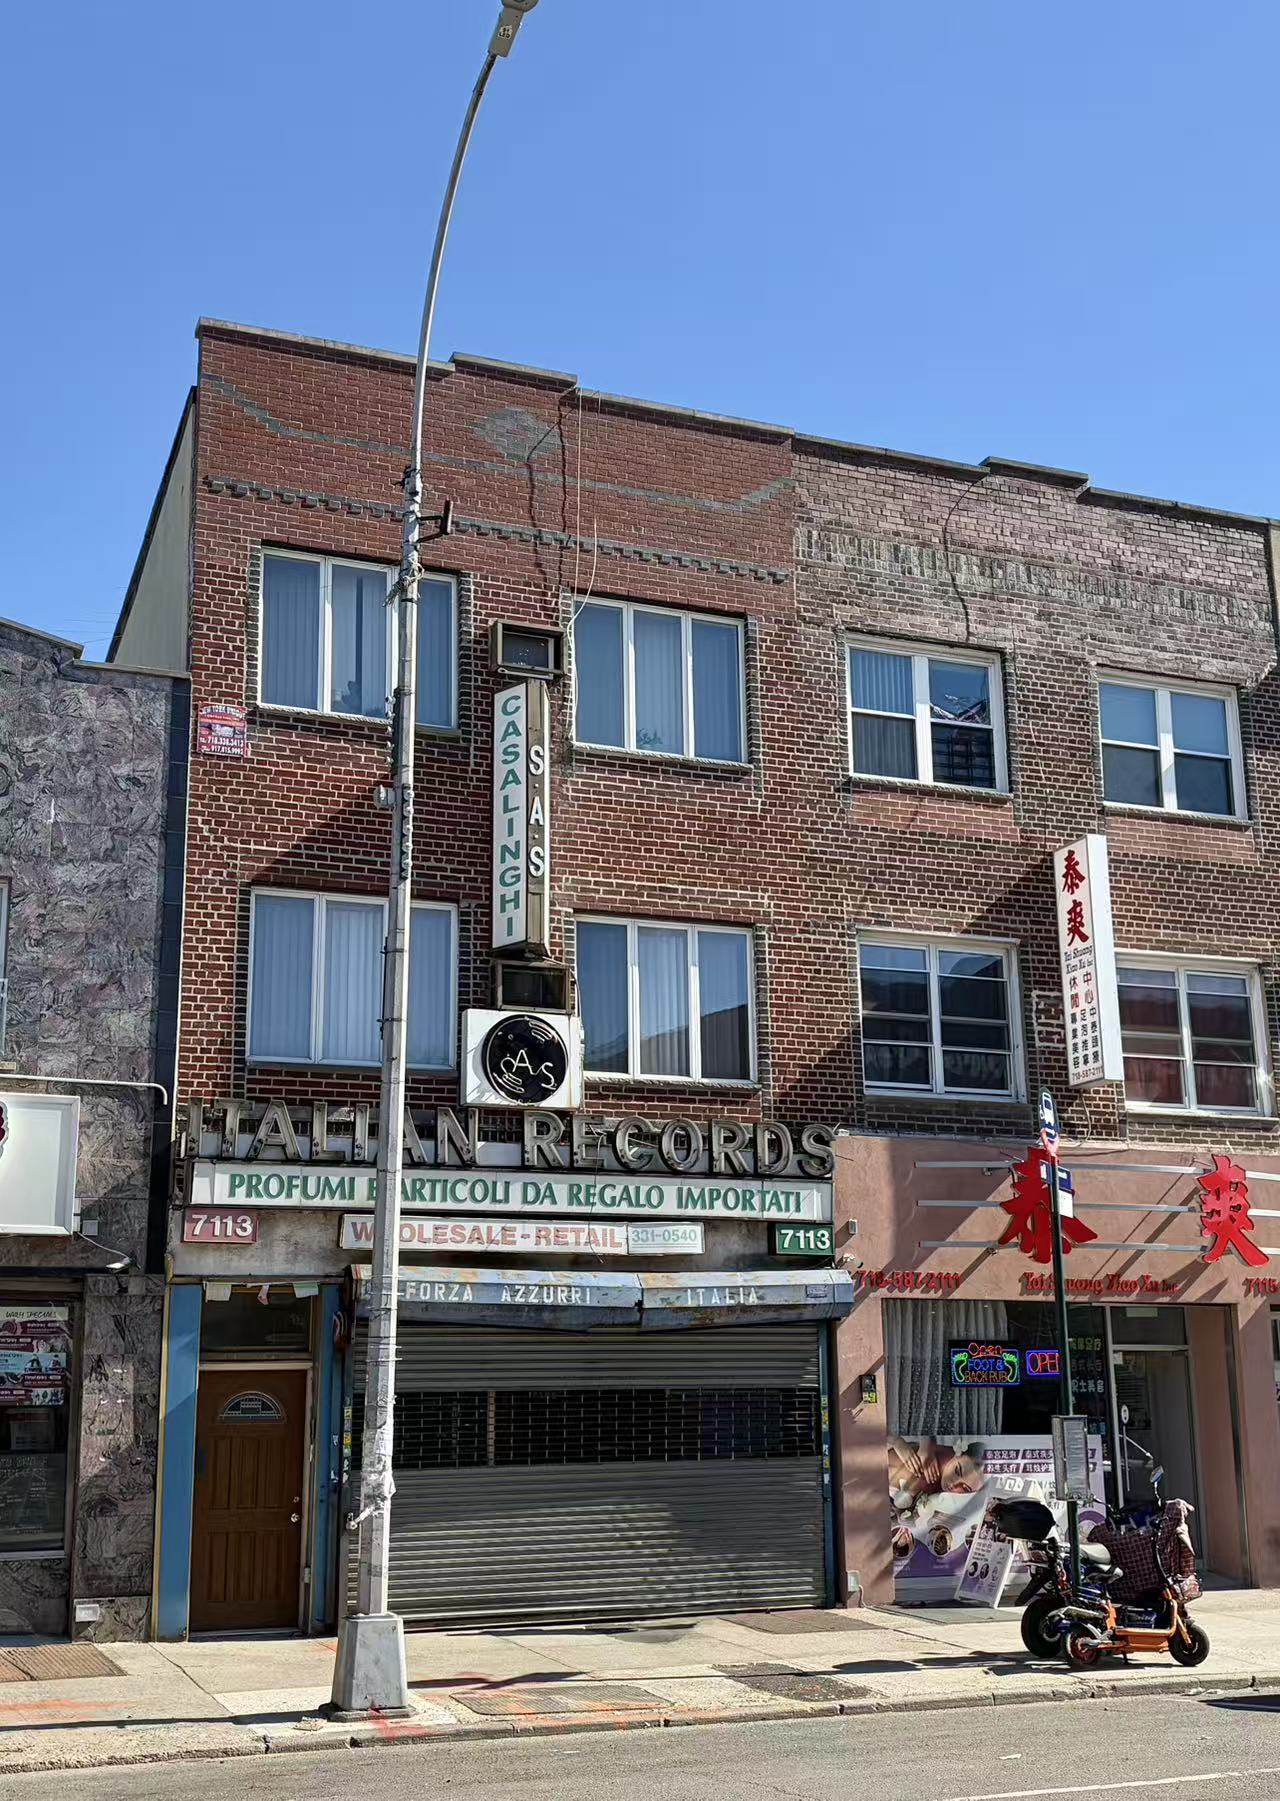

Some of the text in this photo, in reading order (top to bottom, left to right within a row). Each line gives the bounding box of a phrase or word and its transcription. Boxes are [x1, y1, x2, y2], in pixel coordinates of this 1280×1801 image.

[500, 694, 523, 938] CASALINGHI
[186, 1099, 835, 1176] ITALIAN RECORDS
[229, 1173, 356, 1201] PROFUMI
[520, 1181, 558, 1207] DA
[568, 1183, 664, 1210] REGALO
[676, 1186, 802, 1214] IMPORTATI
[191, 1213, 254, 1239] 7113
[351, 1221, 518, 1246] WOLESALE
[538, 1225, 623, 1249] RETAIL
[780, 1228, 831, 1250] 7113
[405, 1281, 591, 1305] FORZA AZZURRI
[687, 1286, 760, 1306] ITALIA
[968, 1343, 1003, 1356] Open
